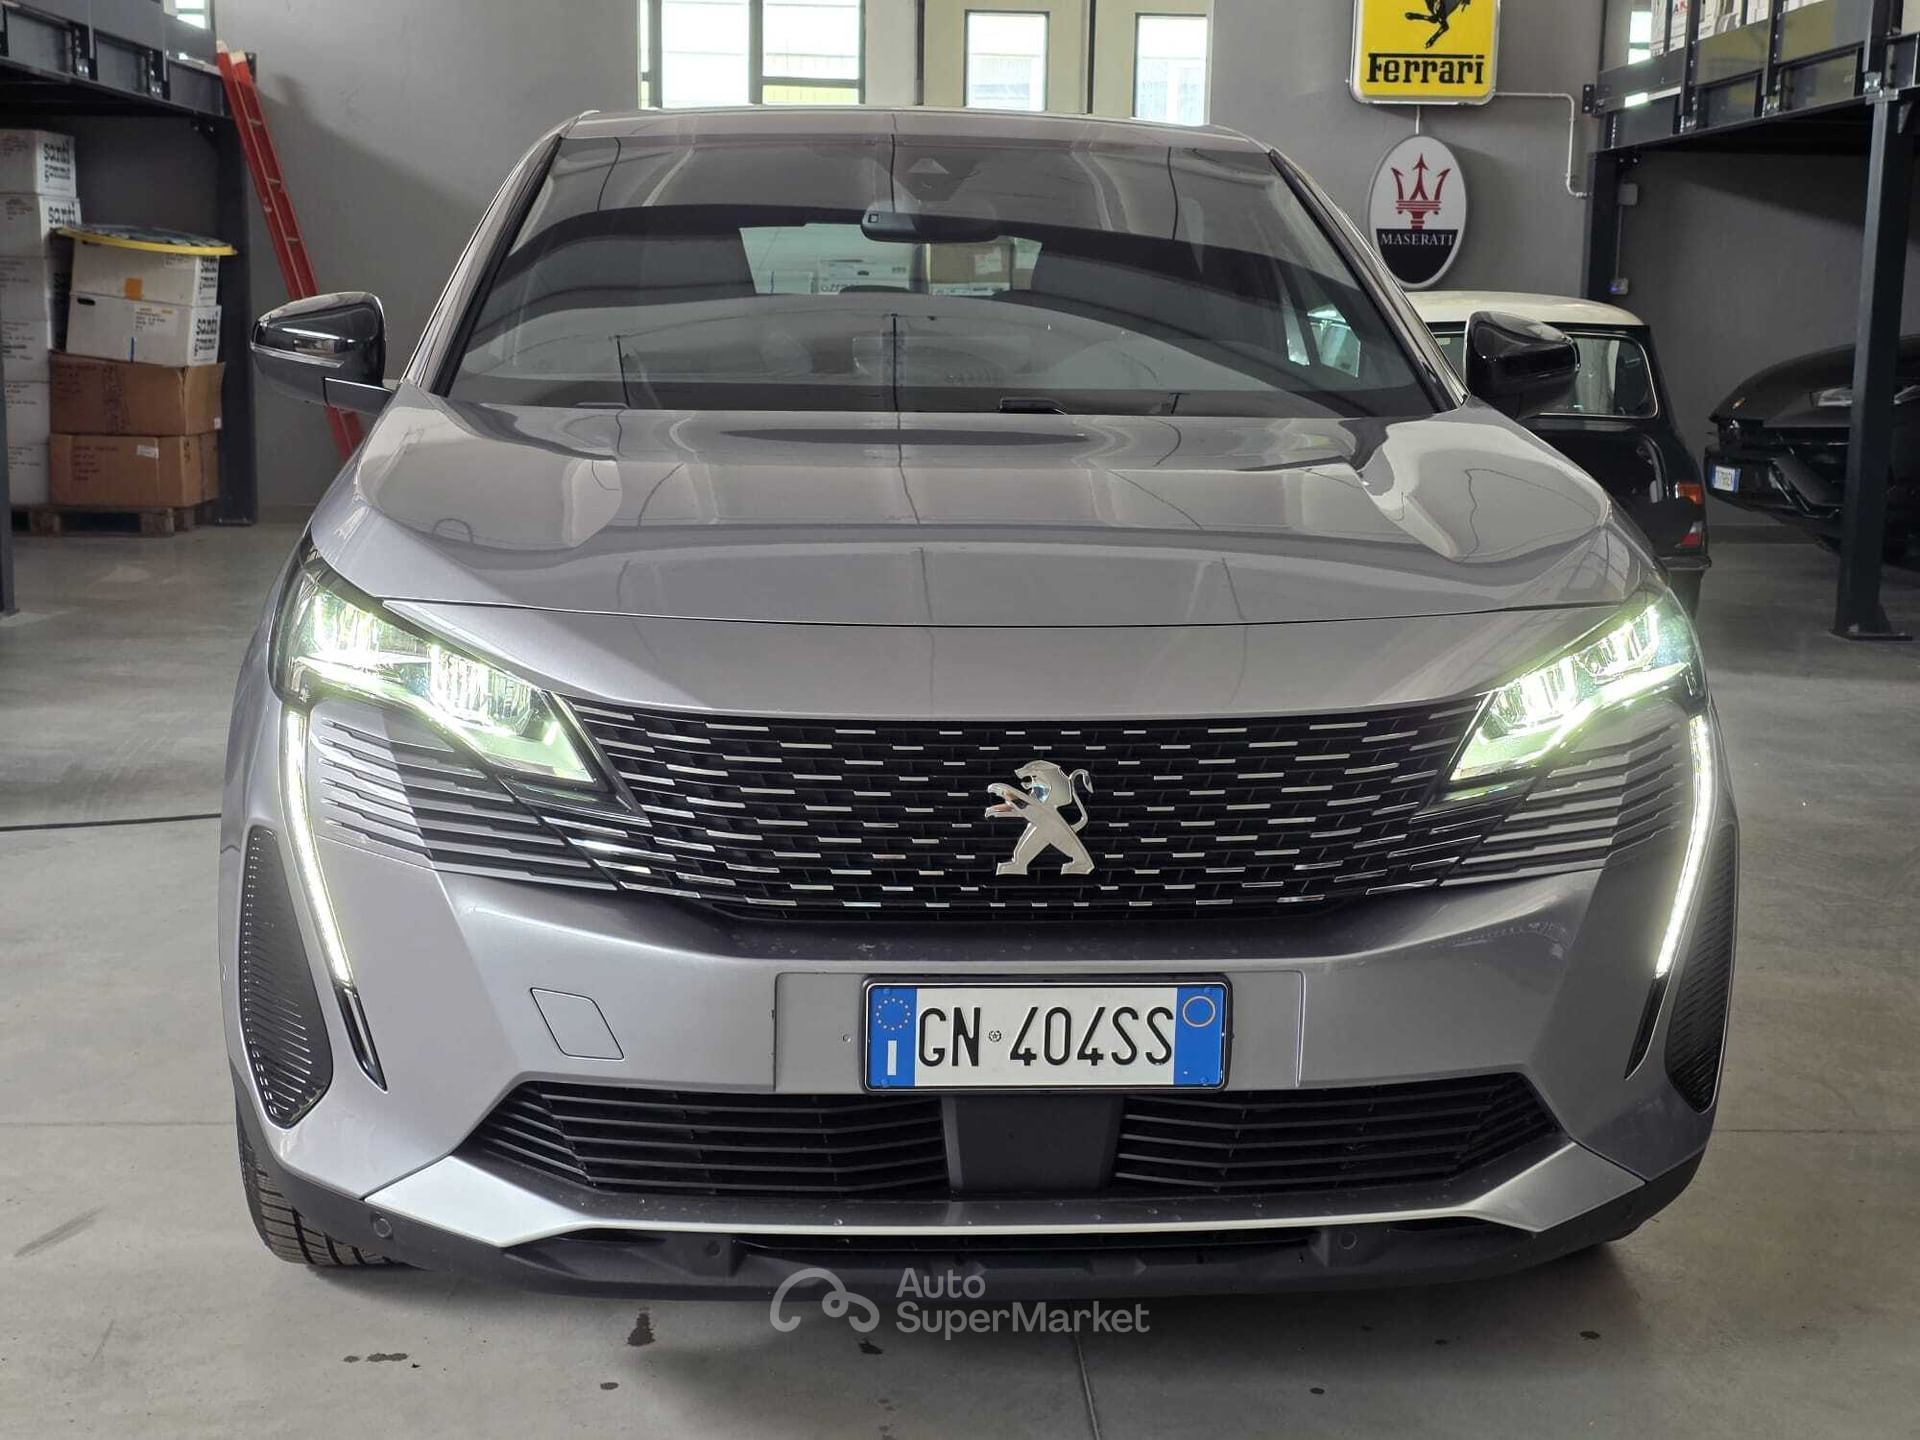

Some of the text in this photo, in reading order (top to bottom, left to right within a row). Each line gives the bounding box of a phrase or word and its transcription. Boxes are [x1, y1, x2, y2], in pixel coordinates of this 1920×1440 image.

[1367, 53, 1485, 84] Ferrari
[1380, 232, 1454, 247] MASERATI
[918, 1006, 981, 1067] GN
[1009, 1006, 1174, 1067] 404SS
